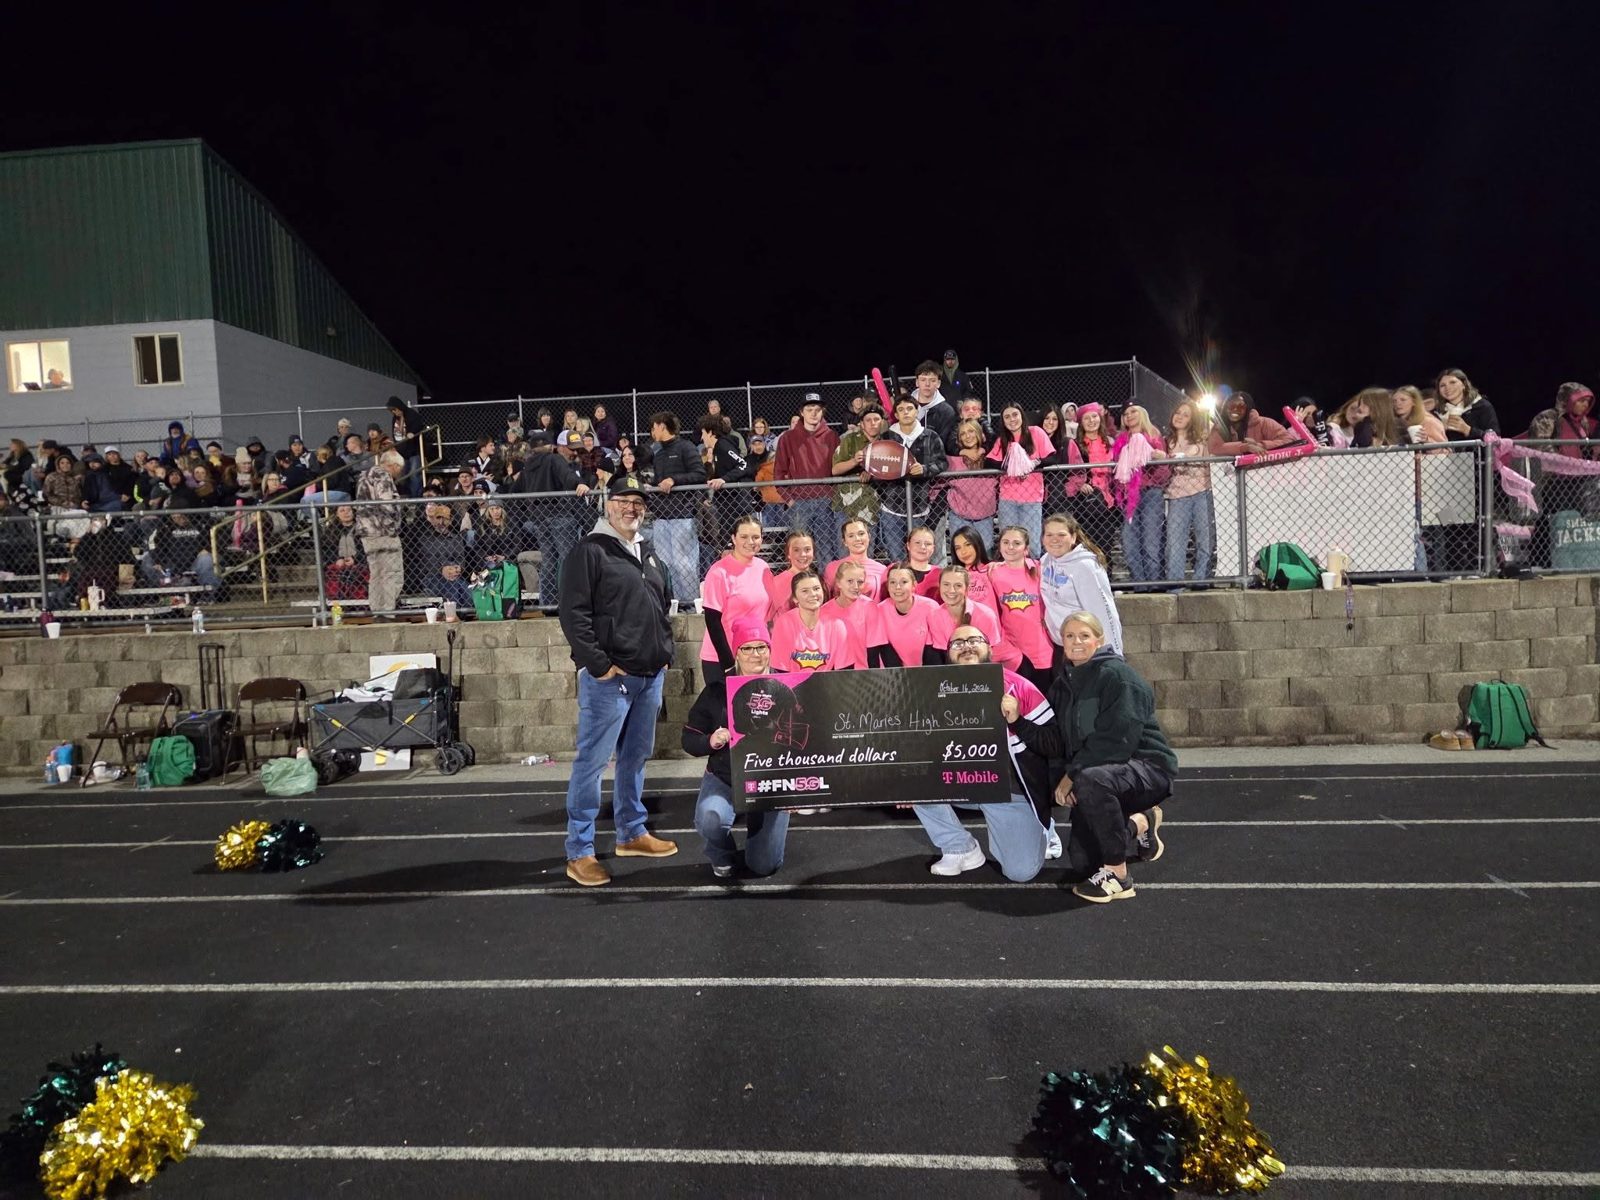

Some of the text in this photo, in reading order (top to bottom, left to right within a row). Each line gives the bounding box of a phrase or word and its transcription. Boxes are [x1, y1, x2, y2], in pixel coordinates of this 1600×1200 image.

[834, 708, 985, 735] St. Maries High School
[744, 746, 897, 770] Five thousand dollars
[942, 740, 998, 761] $5,000
[956, 770, 999, 784] Mobile
